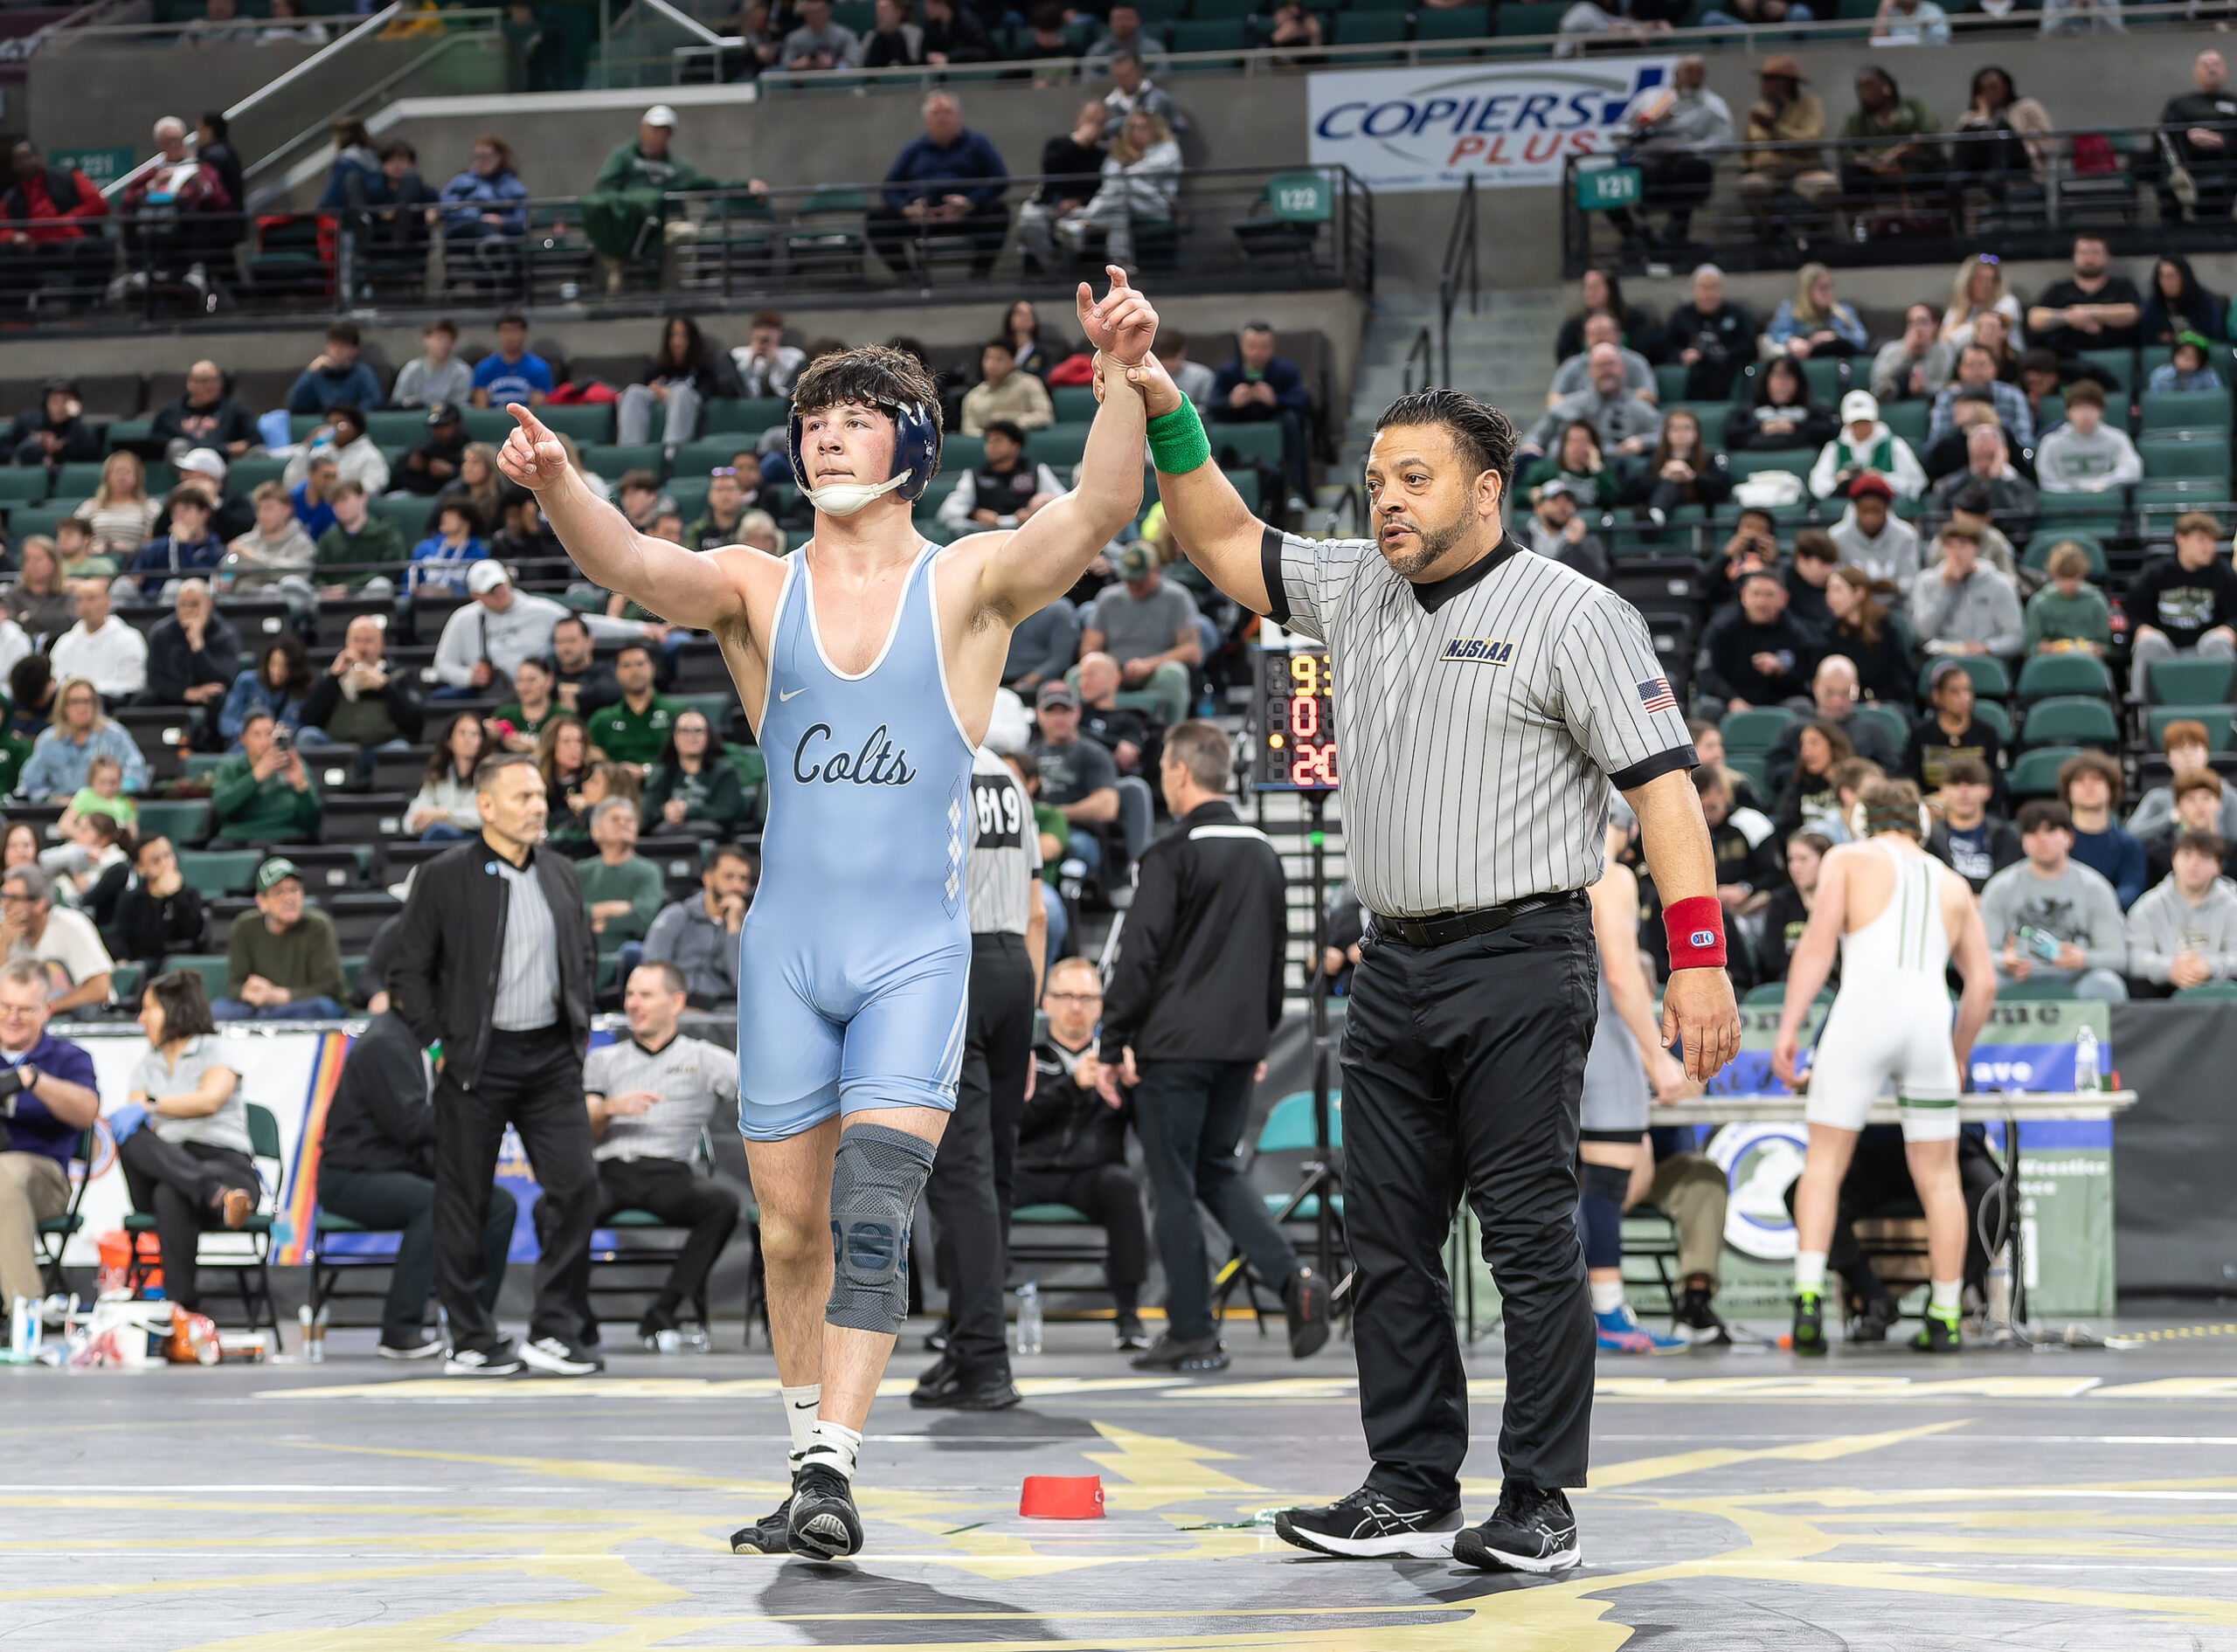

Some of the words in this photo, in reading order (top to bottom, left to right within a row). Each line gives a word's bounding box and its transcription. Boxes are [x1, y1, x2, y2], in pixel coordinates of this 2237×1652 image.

[1316, 90, 1603, 140] COPIERS
[1446, 129, 1598, 168] PLUS
[1280, 187, 1318, 211] 122
[1596, 175, 1634, 198] 121
[793, 722, 917, 785] Colts
[975, 785, 1022, 834] 619
